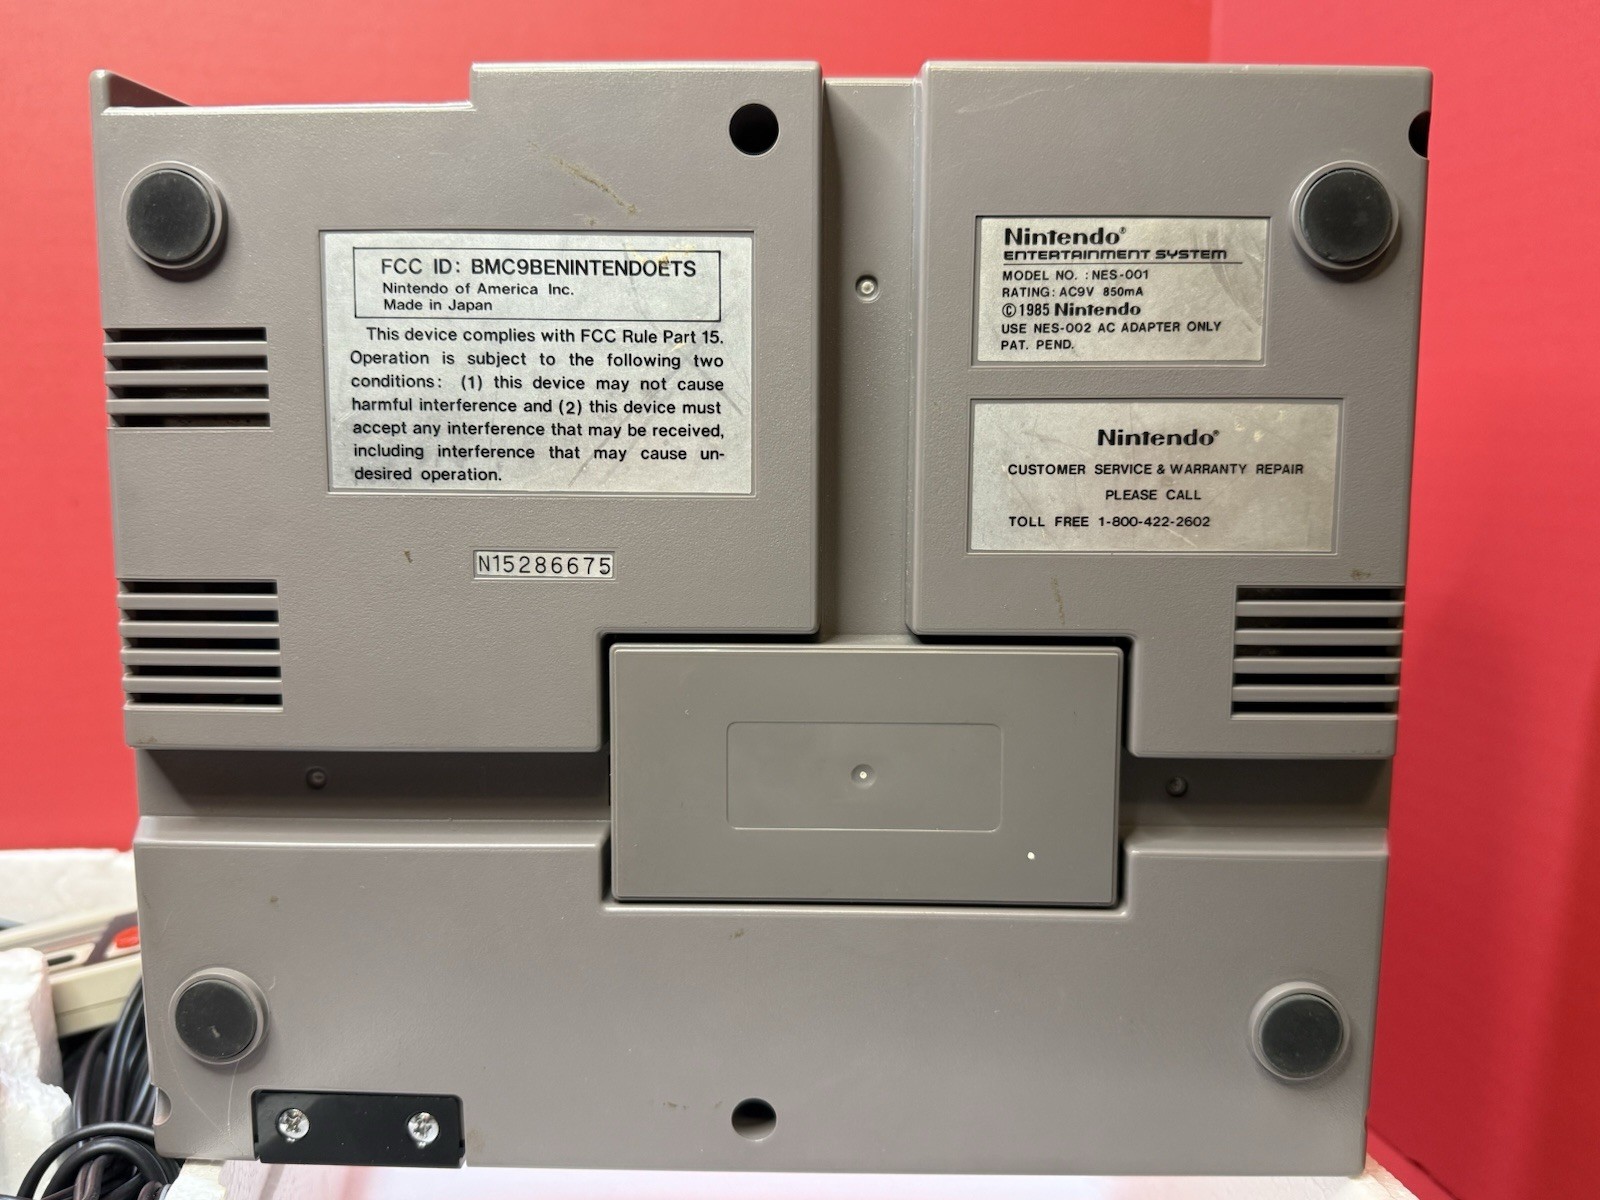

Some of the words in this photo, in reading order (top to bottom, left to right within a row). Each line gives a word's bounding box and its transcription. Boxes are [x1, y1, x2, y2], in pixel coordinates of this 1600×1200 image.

[1003, 249, 1151, 261] ENTERTAINMENT
[1155, 249, 1228, 260] SYSTEM
[381, 257, 423, 275] FCC
[433, 258, 460, 275] ID:
[471, 258, 697, 278] BMC9BENINTENDOETS
[1002, 269, 1050, 281] MODEL
[1055, 269, 1078, 281] NO.
[382, 282, 449, 295] Nintendo
[454, 282, 471, 295] of
[476, 282, 539, 295] America
[548, 283, 574, 296] Inc.
[1002, 286, 1055, 298] RATING:
[1059, 285, 1095, 298] AC9V
[1102, 286, 1144, 297] 850mA
[383, 298, 423, 311] Made
[429, 298, 442, 311] in
[448, 298, 493, 313] Japan
[1054, 301, 1142, 317] Nintendo
[1001, 323, 1027, 335] USE
[1033, 322, 1092, 334] NES-002
[1097, 321, 1116, 334] AC
[1120, 321, 1181, 333] ADAPTER
[1186, 320, 1222, 332] ONLY
[366, 326, 400, 341] This
[404, 327, 458, 342] device
[462, 328, 536, 345] complies
[540, 328, 575, 343] with
[580, 328, 617, 344] FCC
[622, 329, 658, 344] Rule
[663, 329, 697, 344] Part
[701, 330, 724, 344] 15.
[1000, 339, 1029, 351] PAT.
[1036, 339, 1074, 350] PEND.
[350, 349, 430, 367] Operation
[442, 350, 455, 365] is
[467, 351, 527, 368] subject
[539, 352, 556, 366] to
[568, 352, 595, 367] the
[606, 352, 681, 371] following
[693, 354, 724, 368] two
[350, 374, 442, 388] conditions:
[461, 374, 483, 392] (1)
[493, 375, 523, 389] this
[532, 375, 586, 390] device
[596, 379, 630, 393] may
[640, 377, 667, 391] not
[677, 380, 724, 392] cause
[351, 397, 413, 411] harmful
[419, 397, 518, 413] interference
[523, 399, 553, 413] and
[558, 399, 582, 416] (2)
[588, 399, 618, 414] this
[623, 400, 676, 414] device
[682, 401, 722, 415] must
[352, 421, 407, 437] accept
[412, 423, 441, 437] any
[447, 421, 545, 436] interference
[550, 422, 583, 436] that
[588, 426, 622, 439] may
[627, 423, 647, 437] be
[652, 423, 724, 439] received,
[353, 443, 424, 460] including
[437, 444, 535, 459] interference
[548, 445, 581, 459] that
[593, 448, 627, 463] may
[640, 449, 687, 460] cause
[700, 449, 725, 461] un-
[354, 466, 412, 481] desired
[420, 467, 502, 484] operation.
[1007, 463, 1086, 476] CUSTOMER
[1094, 463, 1153, 475] SERVICE
[1156, 463, 1166, 475] &
[1169, 463, 1247, 475] WARRANTY
[1255, 463, 1304, 475] REPAIR
[1105, 489, 1158, 501] PLEASE
[1165, 488, 1202, 501] CALL
[1008, 515, 1046, 528] TOLL
[1054, 516, 1090, 528] FREE
[1098, 516, 1211, 528] 1-800-422-2602
[478, 554, 611, 575] N15286675
